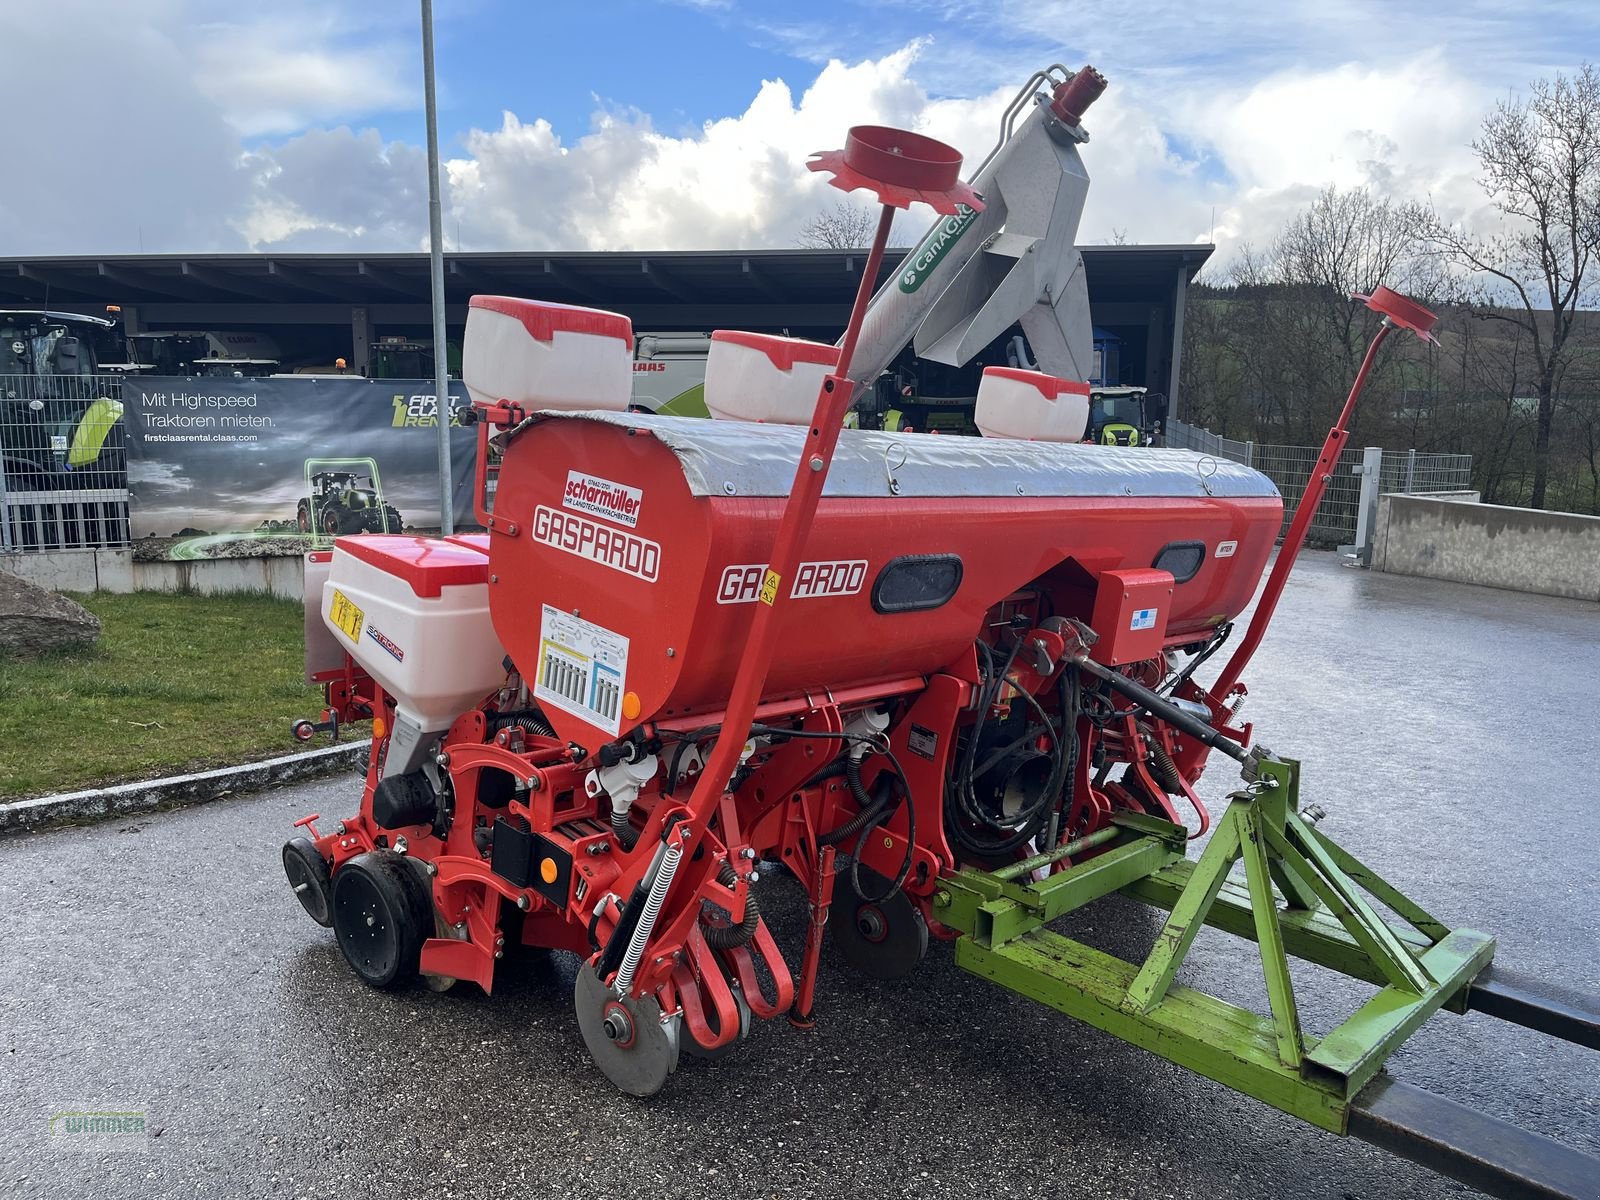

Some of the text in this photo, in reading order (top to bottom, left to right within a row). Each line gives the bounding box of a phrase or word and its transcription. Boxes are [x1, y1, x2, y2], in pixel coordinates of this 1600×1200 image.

[633, 363, 665, 371] LAAS
[142, 393, 257, 409] Mit Highspeed
[408, 395, 460, 406] FIRT
[142, 413, 276, 428] Traktoren mieten.
[143, 433, 258, 442] firstclaasrental.claas.com
[566, 479, 640, 515] scharmüller
[572, 500, 636, 524] LANDTECHNIKFACHBETRIEB
[534, 507, 659, 580] GASPARDO
[719, 562, 866, 601] GAARDO
